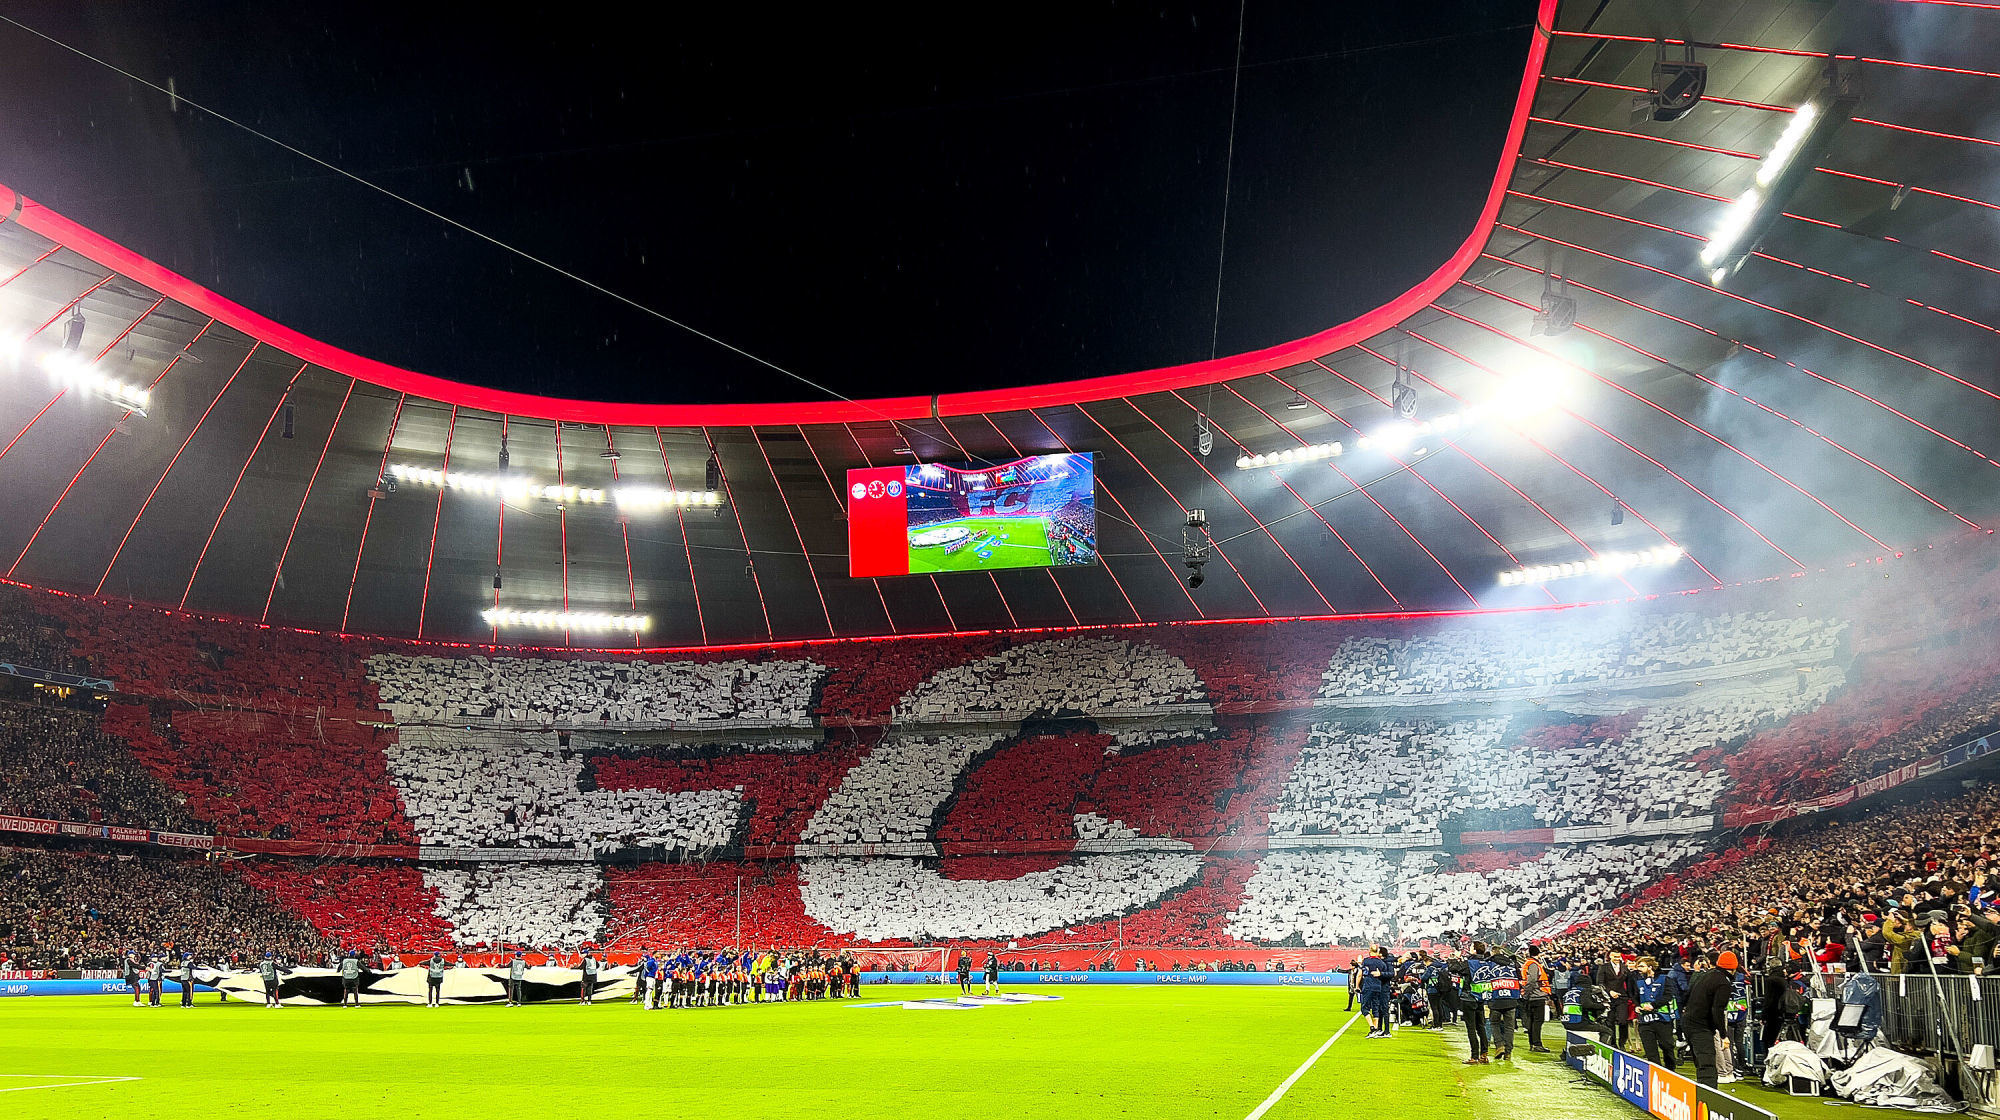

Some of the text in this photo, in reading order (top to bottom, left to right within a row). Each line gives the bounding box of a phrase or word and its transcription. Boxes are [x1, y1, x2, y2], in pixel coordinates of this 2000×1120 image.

[0, 818, 56, 834] WEIDBACH
[159, 835, 212, 848] SEELAND
[31, 970, 44, 979] 93
[1039, 974, 1063, 982] PEACE
[1156, 974, 1181, 982] PEACE
[1278, 975, 1304, 983] PEACE
[102, 983, 127, 992] PEACE
[1492, 980, 1515, 989] PHOTO
[1625, 1063, 1644, 1098] PS5
